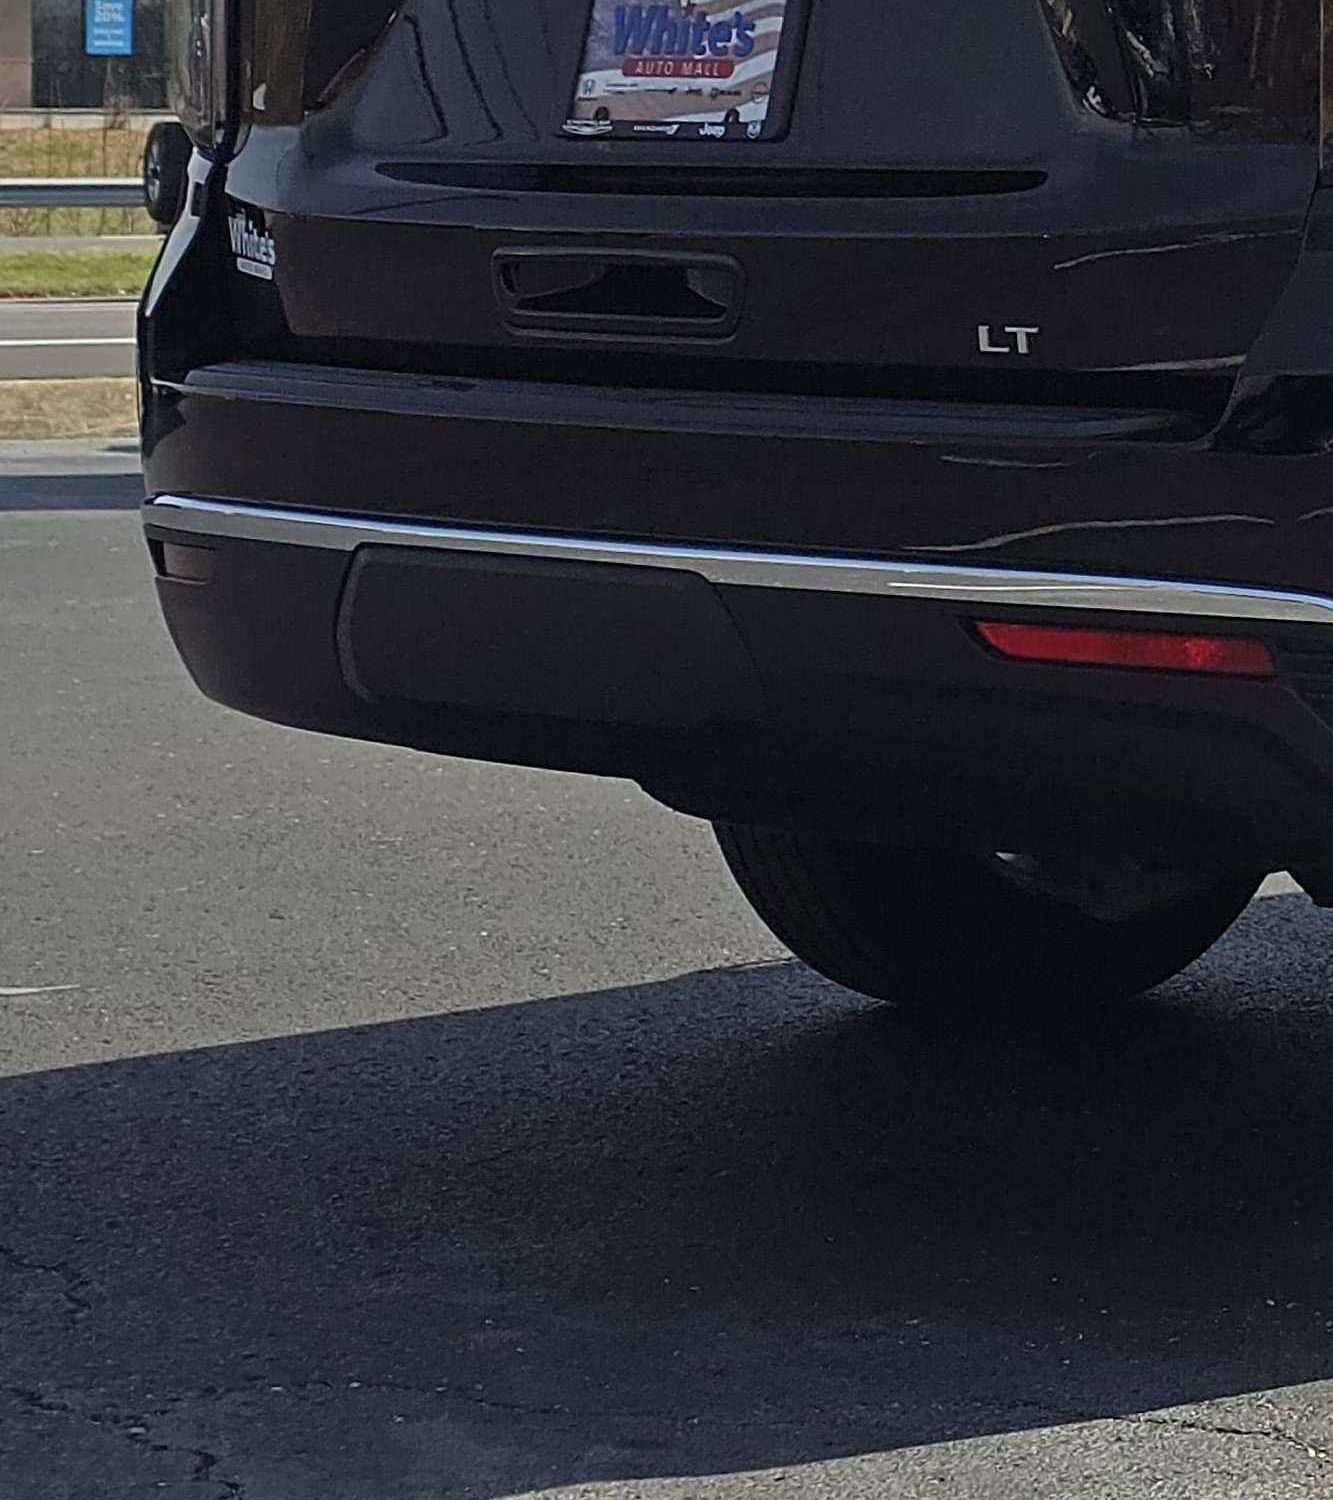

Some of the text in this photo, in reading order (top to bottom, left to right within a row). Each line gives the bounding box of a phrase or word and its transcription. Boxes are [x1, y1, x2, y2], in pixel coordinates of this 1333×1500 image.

[614, 3, 756, 57] White's
[635, 62, 719, 76] AUTO MALL
[978, 325, 1040, 353] LT
